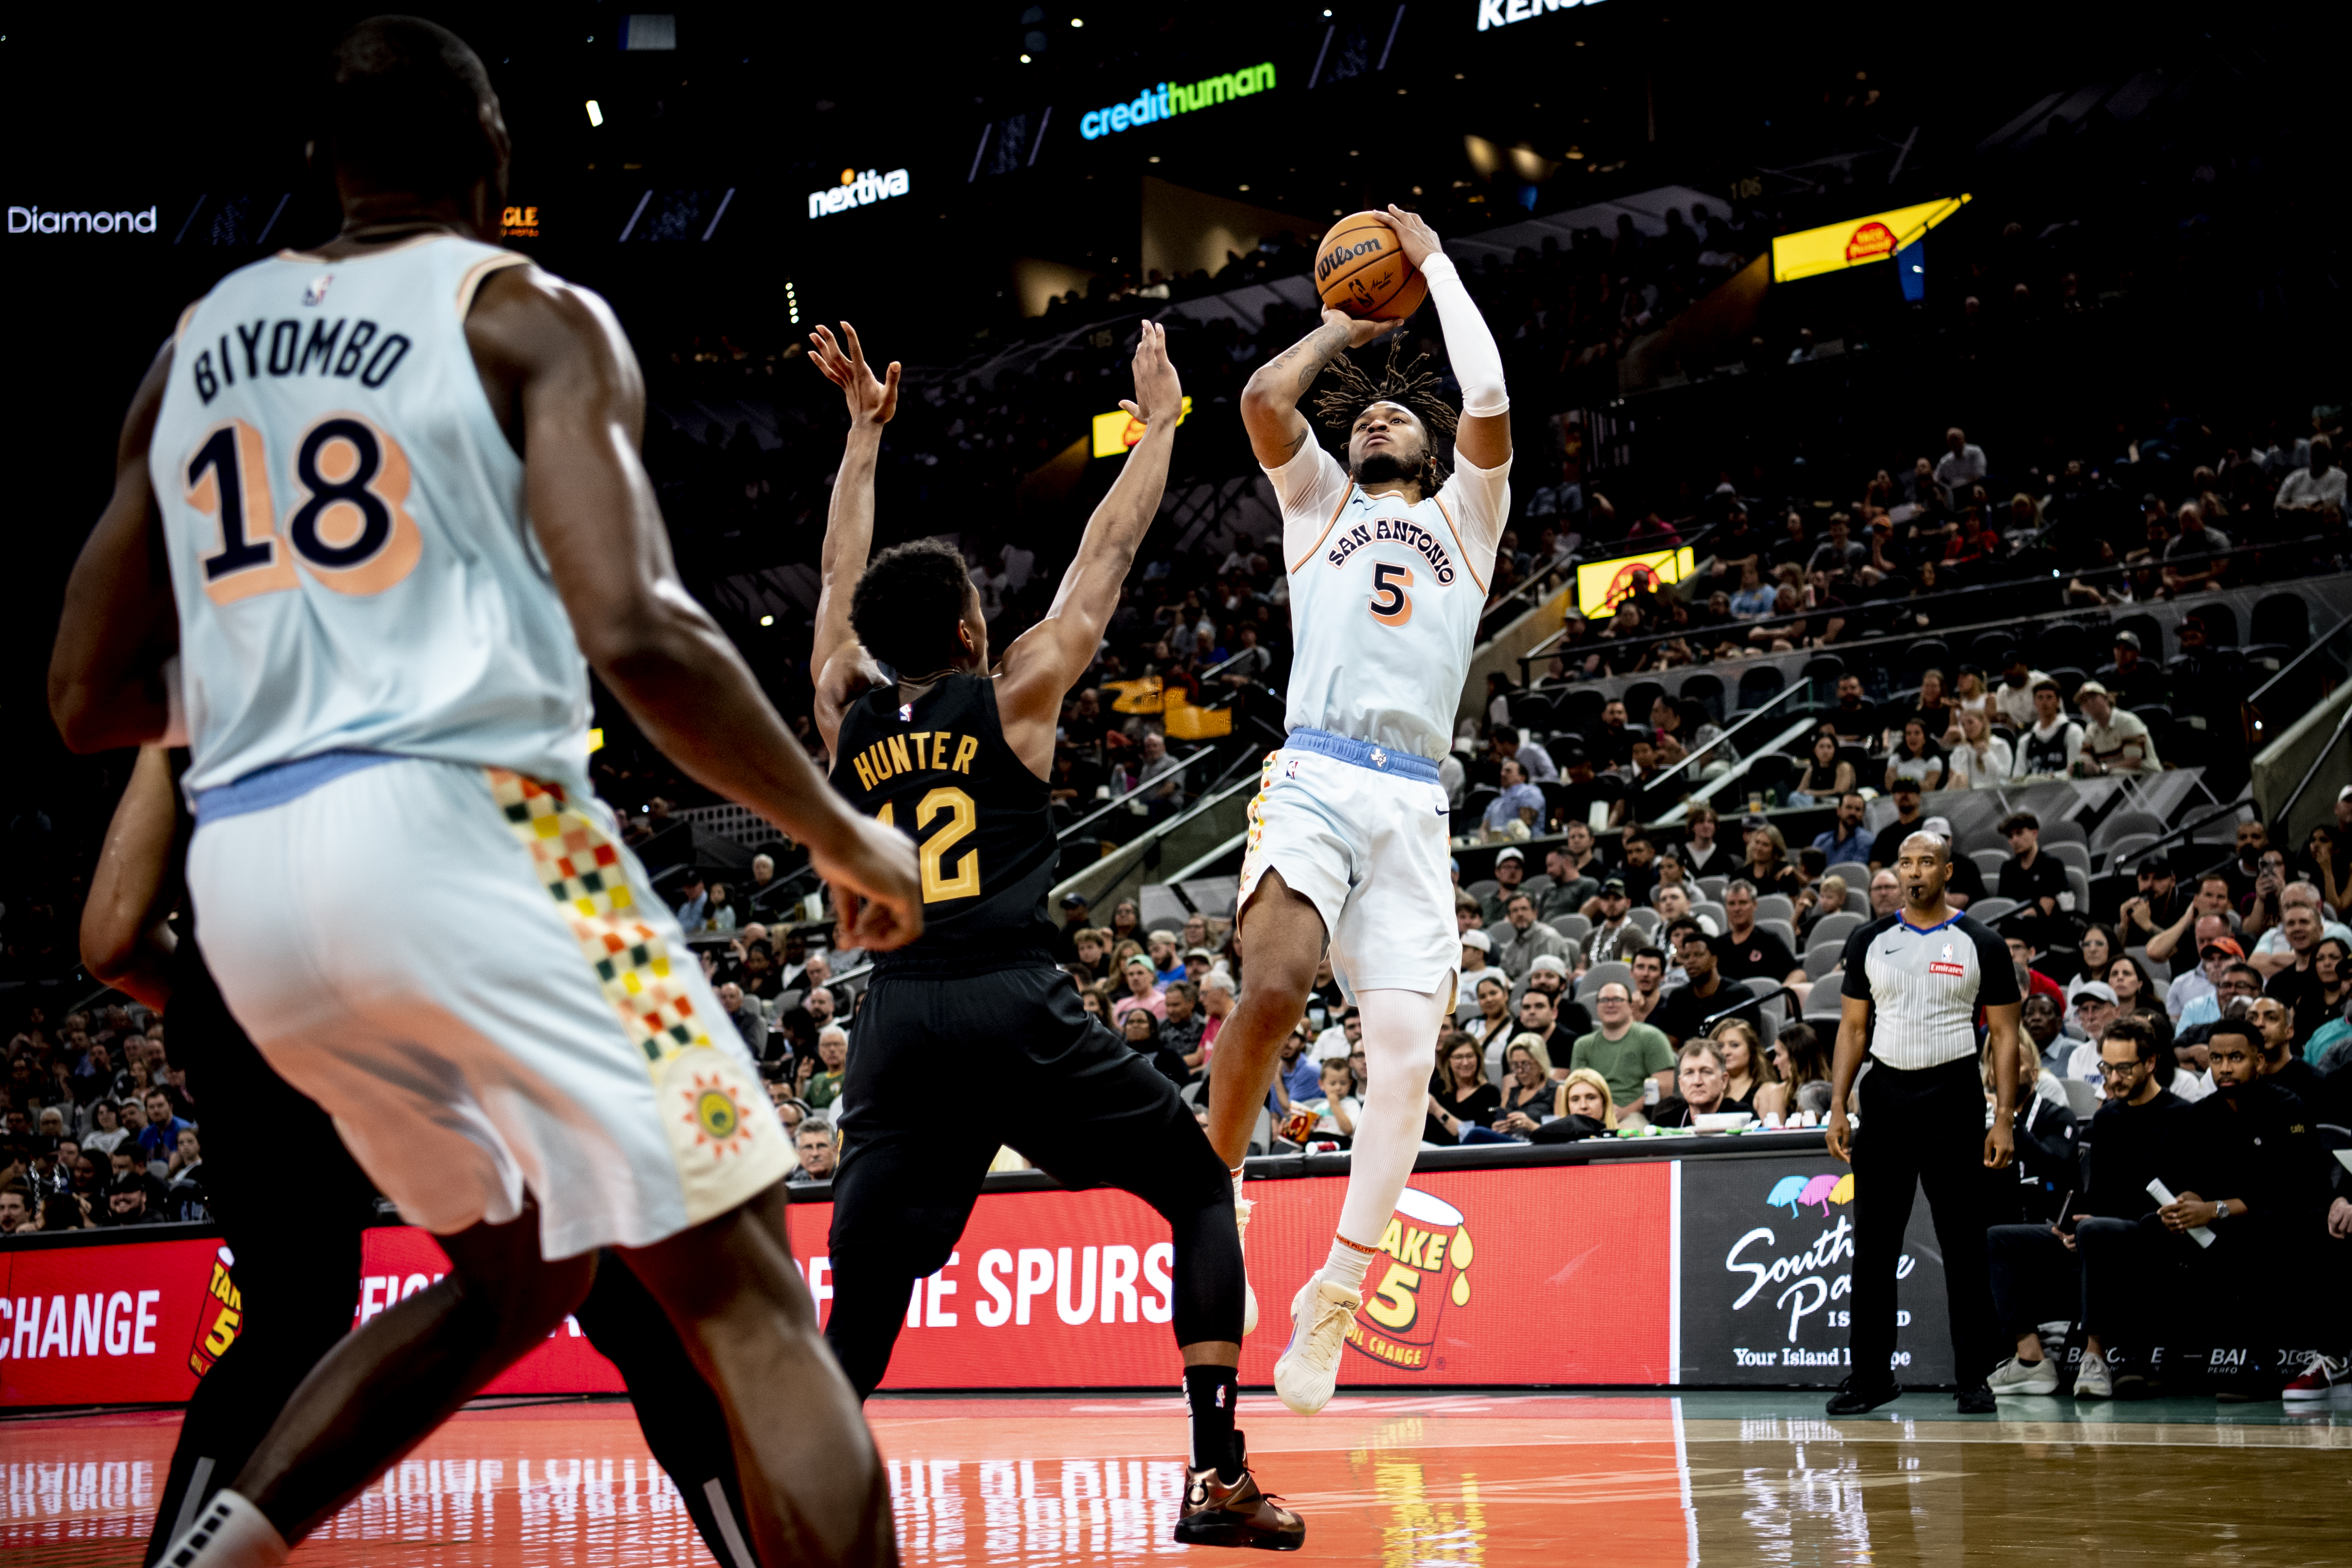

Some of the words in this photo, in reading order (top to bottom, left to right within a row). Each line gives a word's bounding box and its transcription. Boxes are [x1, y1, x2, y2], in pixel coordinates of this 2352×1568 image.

[1080, 61, 1277, 140] credithuman
[8, 206, 156, 233] Diamond
[502, 206, 539, 227] GLE
[808, 168, 910, 219] nextiva
[1317, 238, 1382, 281] Wilson
[194, 318, 412, 406] BIYOMBO
[189, 417, 393, 583] 18
[1327, 523, 1373, 568] SAN
[1375, 519, 1455, 585] ANTONIO
[1369, 562, 1407, 617] 5
[853, 731, 978, 791] HUNTER
[875, 786, 980, 904] 2
[1931, 963, 1963, 975] Emirates
[1378, 1218, 1447, 1271] AKE
[1726, 1215, 1854, 1310] South
[976, 1243, 1173, 1327] SPURS
[1365, 1262, 1420, 1328] 5
[205, 1306, 240, 1358] 5
[1369, 1336, 1422, 1365] CHANGE
[1733, 1348, 1777, 1366] Your
[1782, 1347, 1840, 1366] Island
